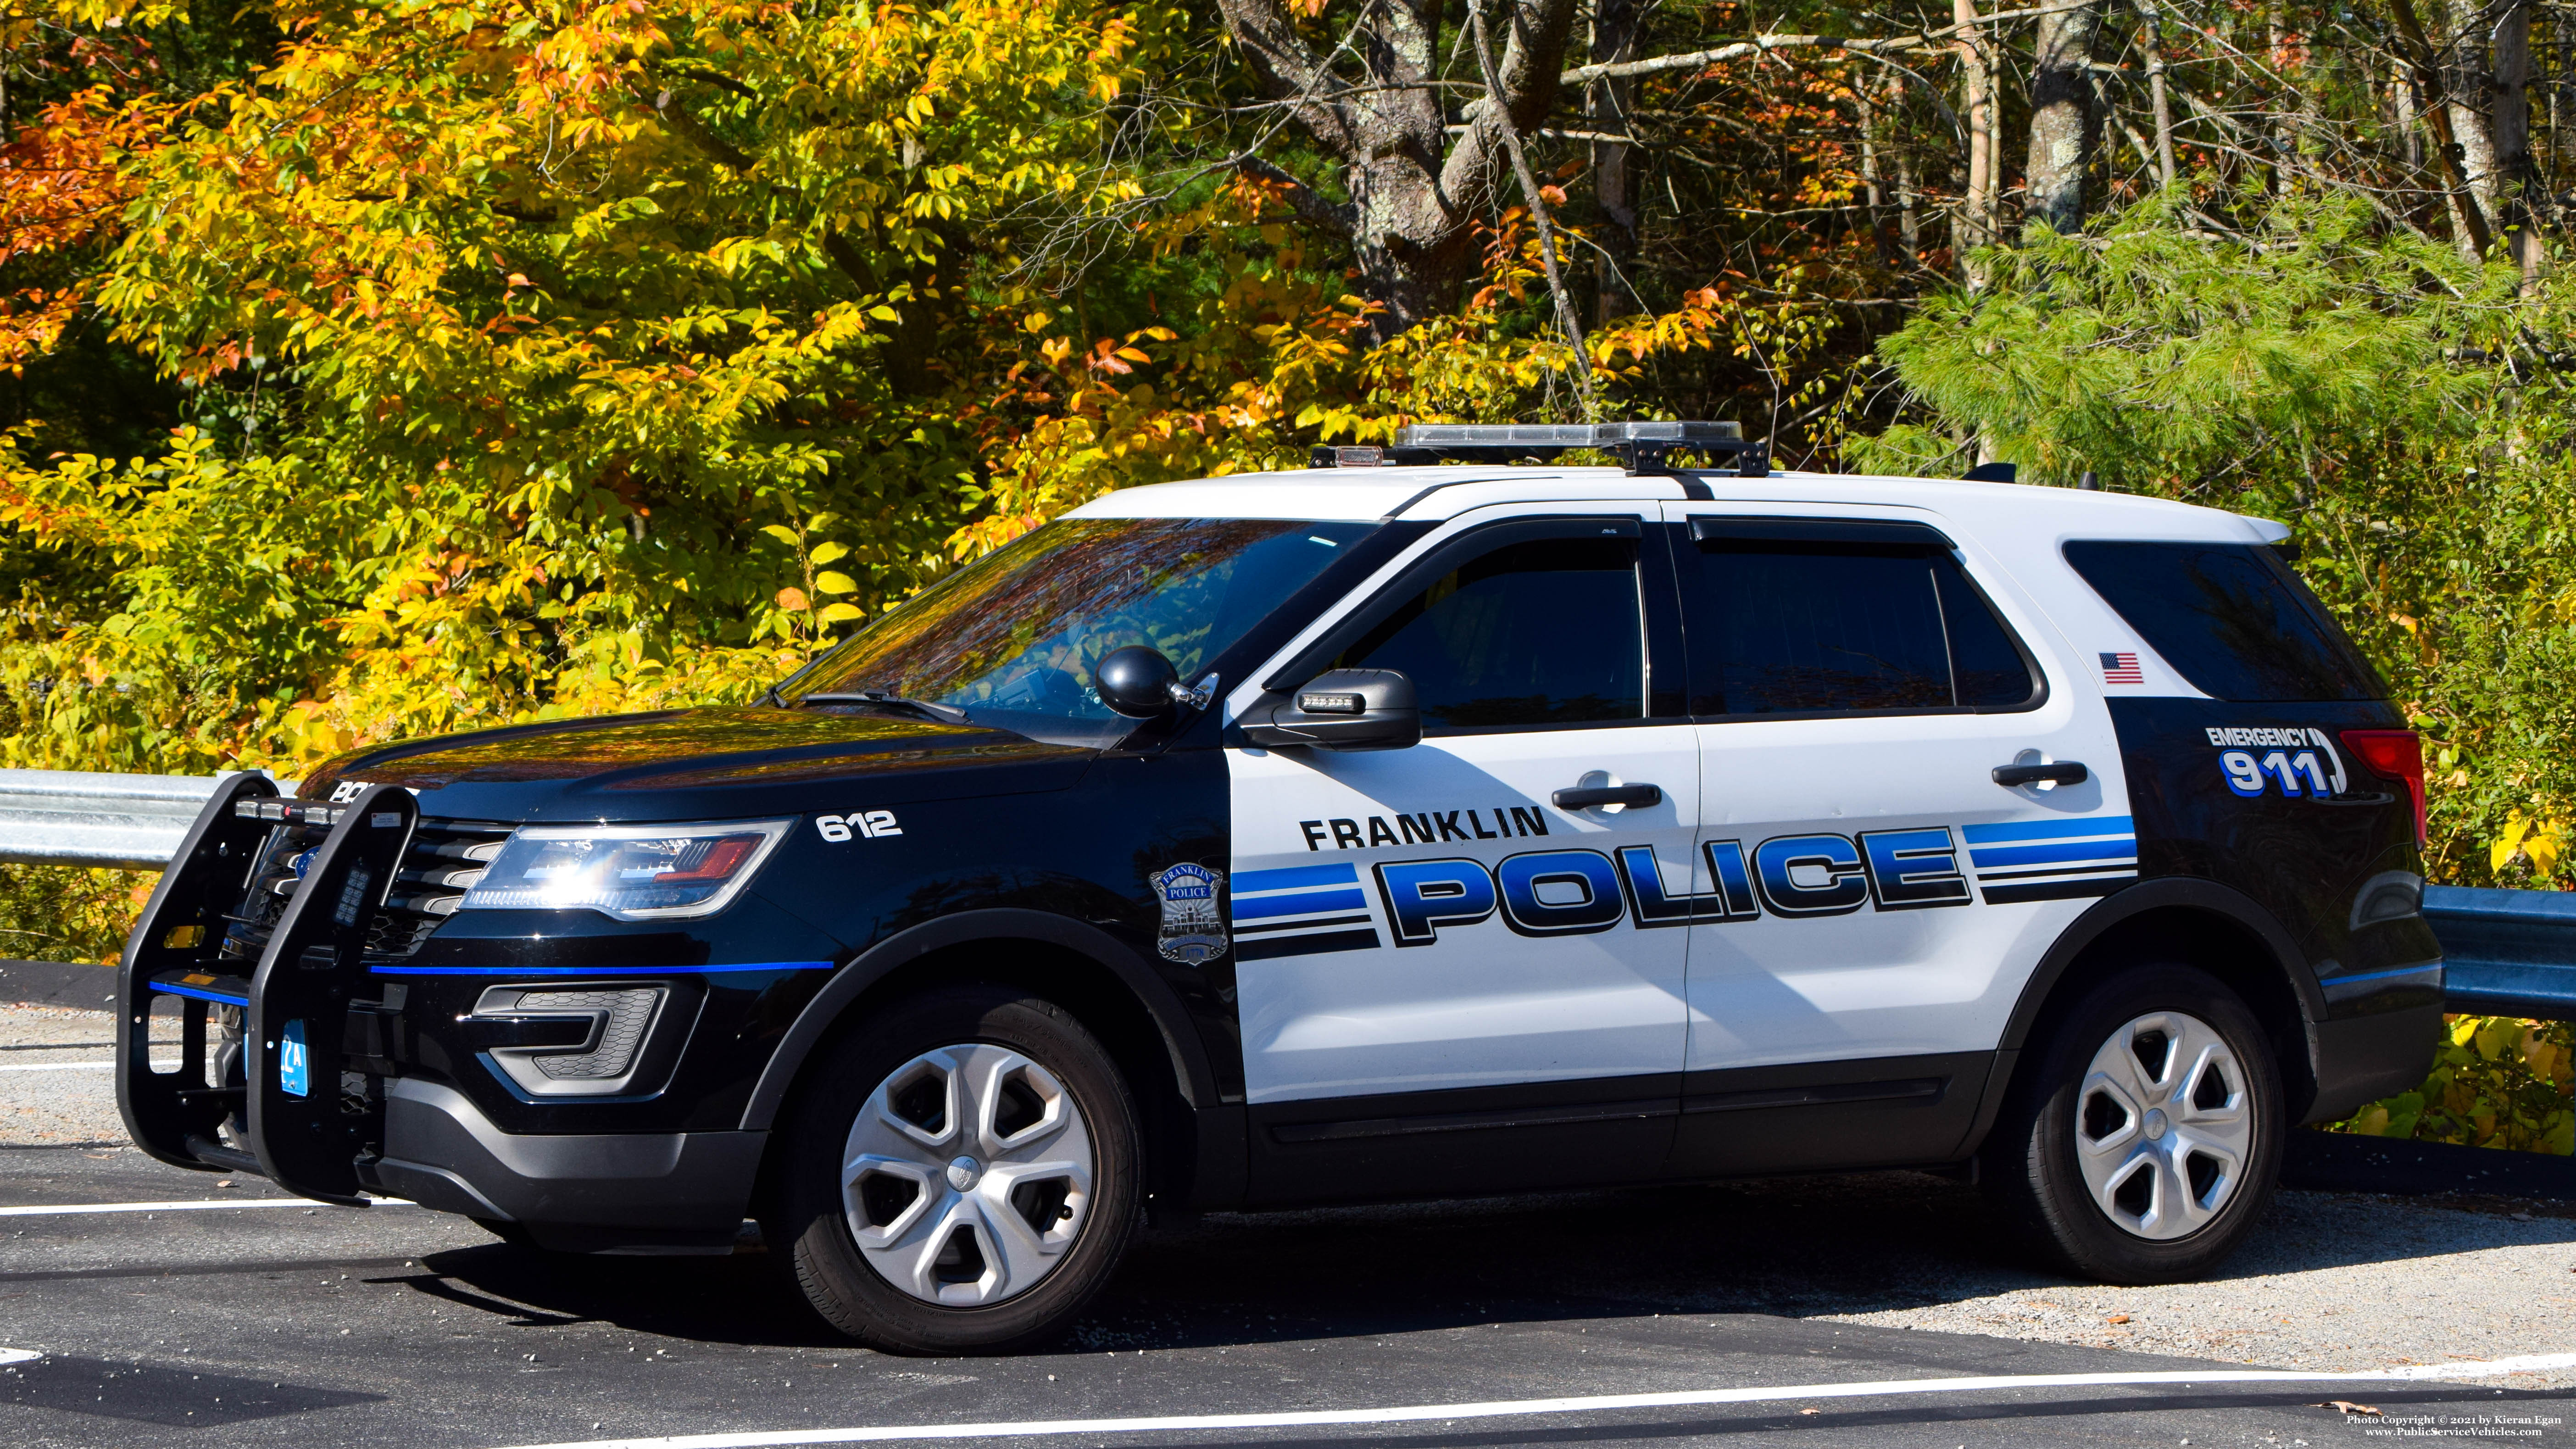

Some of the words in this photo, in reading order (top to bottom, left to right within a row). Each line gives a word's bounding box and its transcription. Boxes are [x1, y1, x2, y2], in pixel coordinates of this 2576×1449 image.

[2205, 727, 2309, 747] EMERGENCY
[2219, 749, 2331, 798] 911
[815, 810, 903, 842] 612
[1299, 806, 1550, 852] FRANKLIN
[1163, 865, 1211, 884] FRANKLIN
[1170, 887, 1207, 898] POLICE
[1371, 825, 1974, 948] POLICE
[1167, 935, 1220, 949] MASSACHUSETTS
[1186, 948, 1204, 957] 1778
